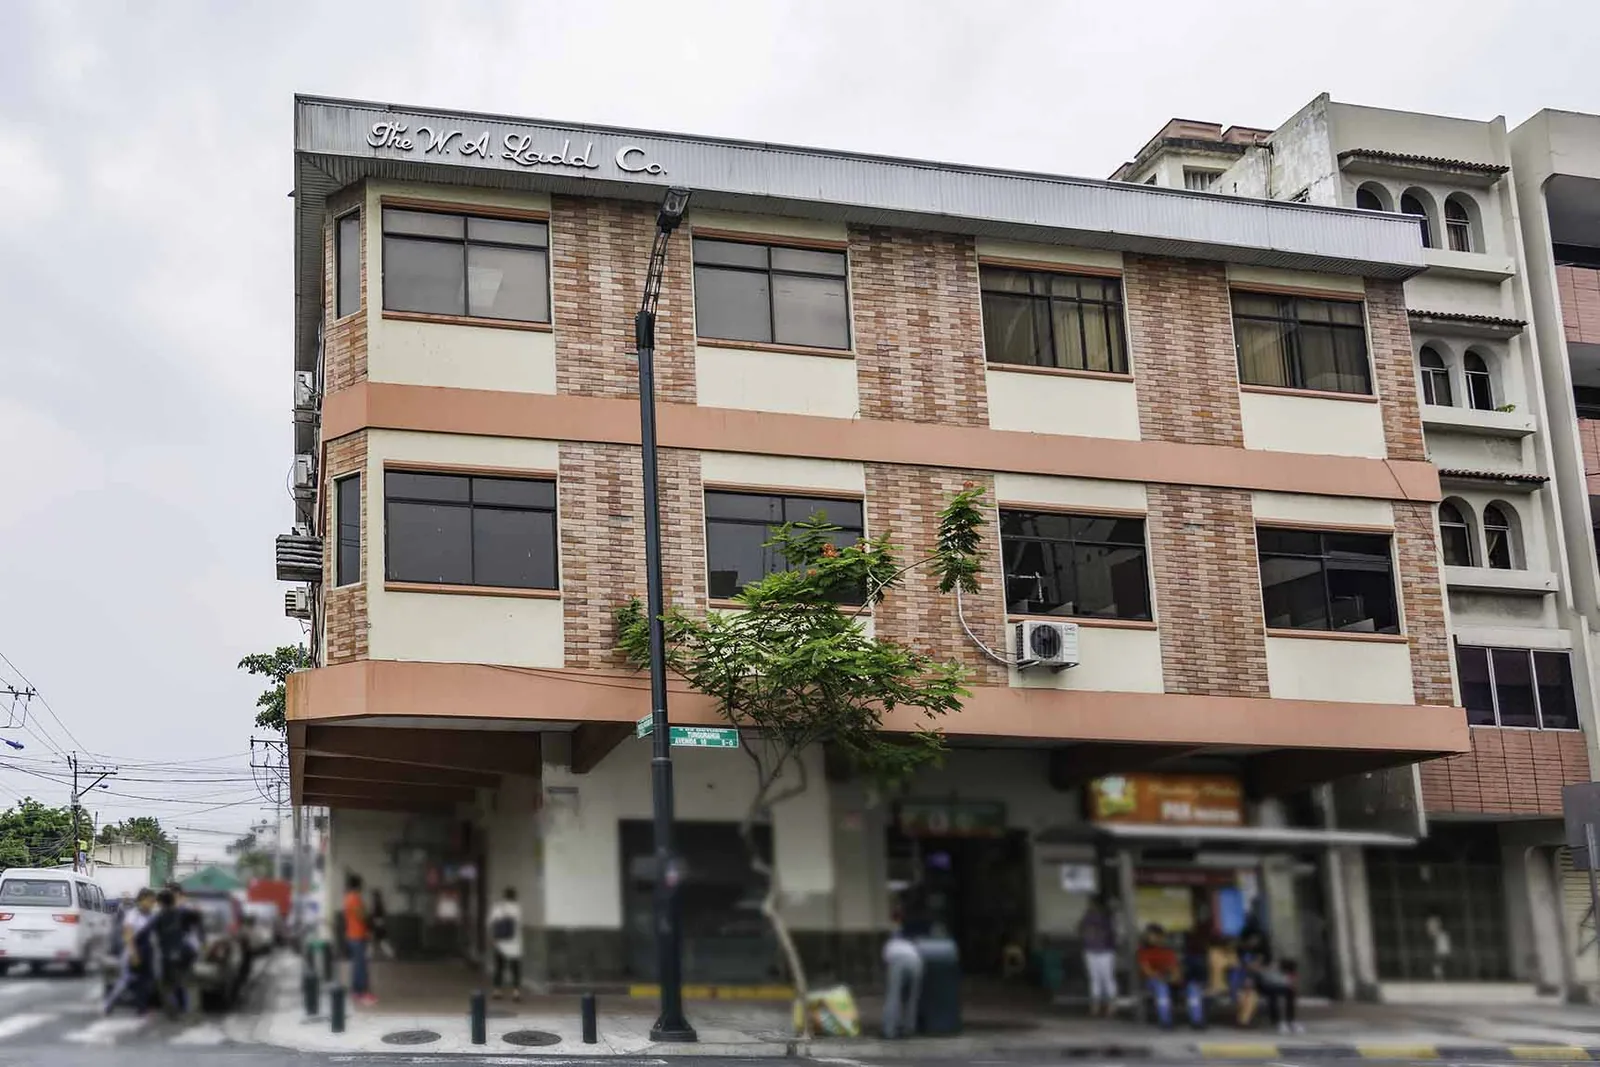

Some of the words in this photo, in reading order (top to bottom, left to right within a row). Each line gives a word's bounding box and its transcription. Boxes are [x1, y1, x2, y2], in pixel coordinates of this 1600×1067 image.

[366, 121, 414, 151] The
[502, 133, 599, 169] Ladd
[615, 145, 668, 175] Co.
